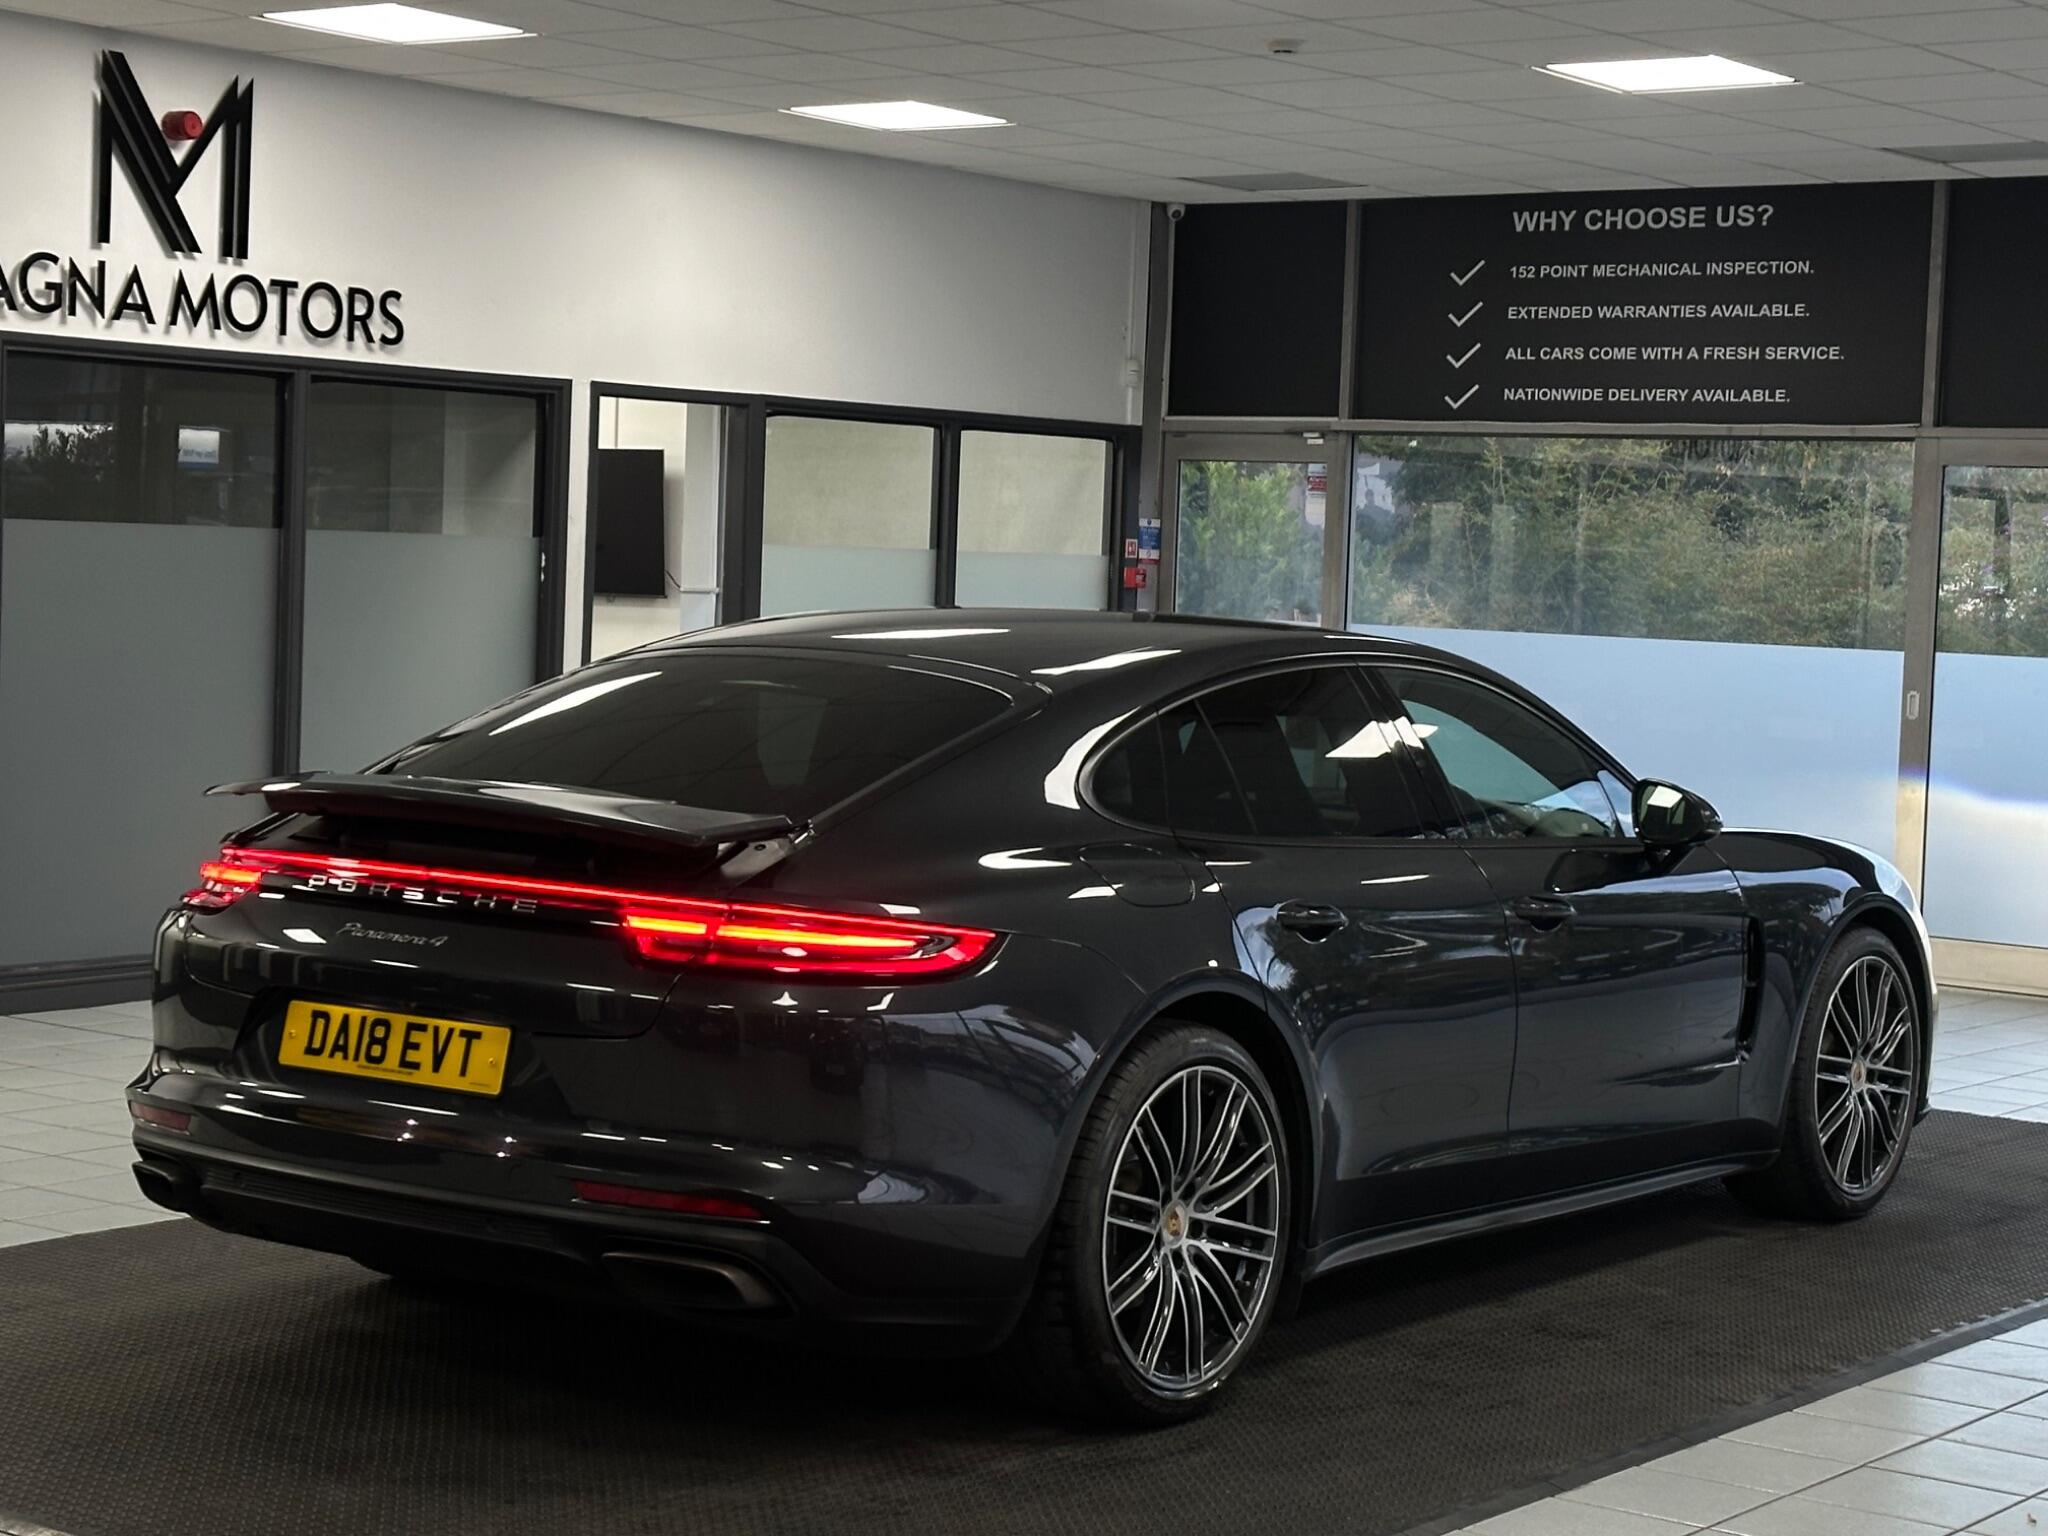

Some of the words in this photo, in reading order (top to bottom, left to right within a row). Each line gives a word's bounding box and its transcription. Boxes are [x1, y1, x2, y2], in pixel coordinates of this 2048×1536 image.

[1513, 210, 1576, 232] WHY
[1585, 207, 1706, 230] CHOOSE
[1717, 205, 1773, 227] US?
[1510, 266, 1535, 278] 152
[1540, 265, 1588, 278] POINT
[1593, 263, 1701, 277] MECHANICAL
[1707, 261, 1813, 275] INSPECTION.
[168, 269, 404, 346] MOTORS
[1508, 306, 1592, 319] EXTENDED
[1598, 305, 1706, 318] WARRANTIES
[1711, 304, 1809, 317] AVAILABLE.
[1505, 348, 1535, 360] ALL
[1540, 347, 1584, 360] CARS
[1589, 347, 1637, 360] COME
[1642, 347, 1683, 360] WITH
[1687, 347, 1699, 360] A
[1704, 347, 1759, 360] FRESH
[1765, 346, 1844, 360] SERVICE.
[1504, 388, 1603, 401] NATIONWIDE
[1608, 389, 1689, 402] DELIVERY
[1692, 389, 1790, 402] AVAILABLE.
[307, 875, 539, 914] PORSCHE
[335, 922, 429, 946] Panamera
[303, 1009, 392, 1066] DA18
[397, 1021, 483, 1079] EVT
